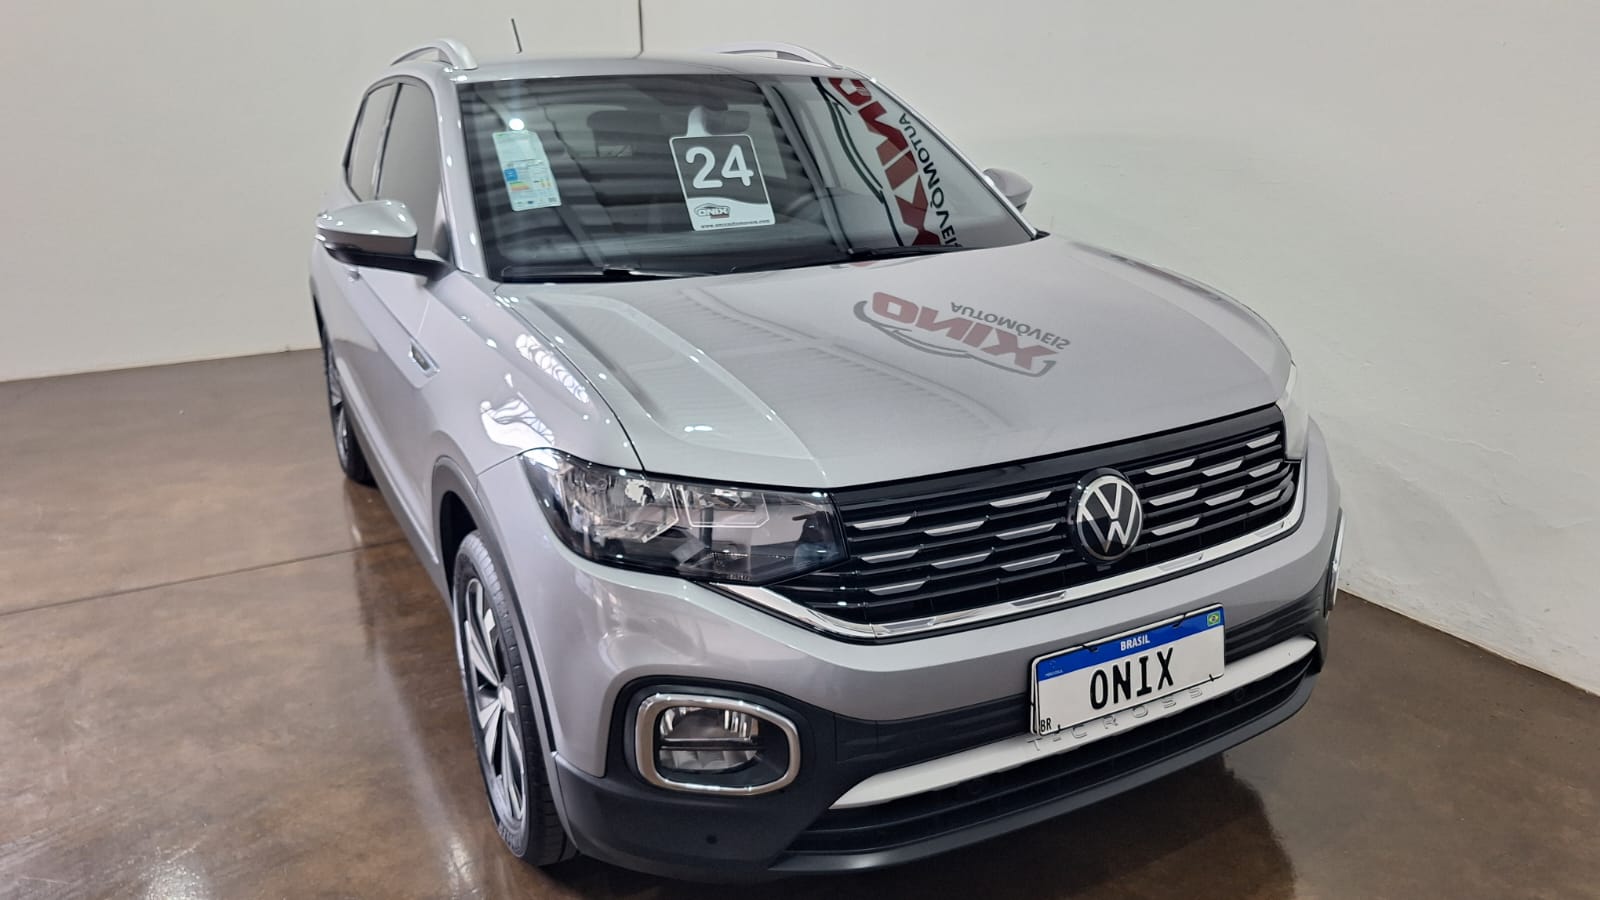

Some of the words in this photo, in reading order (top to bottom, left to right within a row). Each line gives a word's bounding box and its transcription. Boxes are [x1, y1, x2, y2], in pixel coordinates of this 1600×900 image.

[686, 145, 754, 188] 24
[698, 208, 728, 216] ONIX
[1120, 634, 1151, 651] BRASIL
[1089, 647, 1174, 710] ONIX
[1040, 717, 1052, 732] BR
